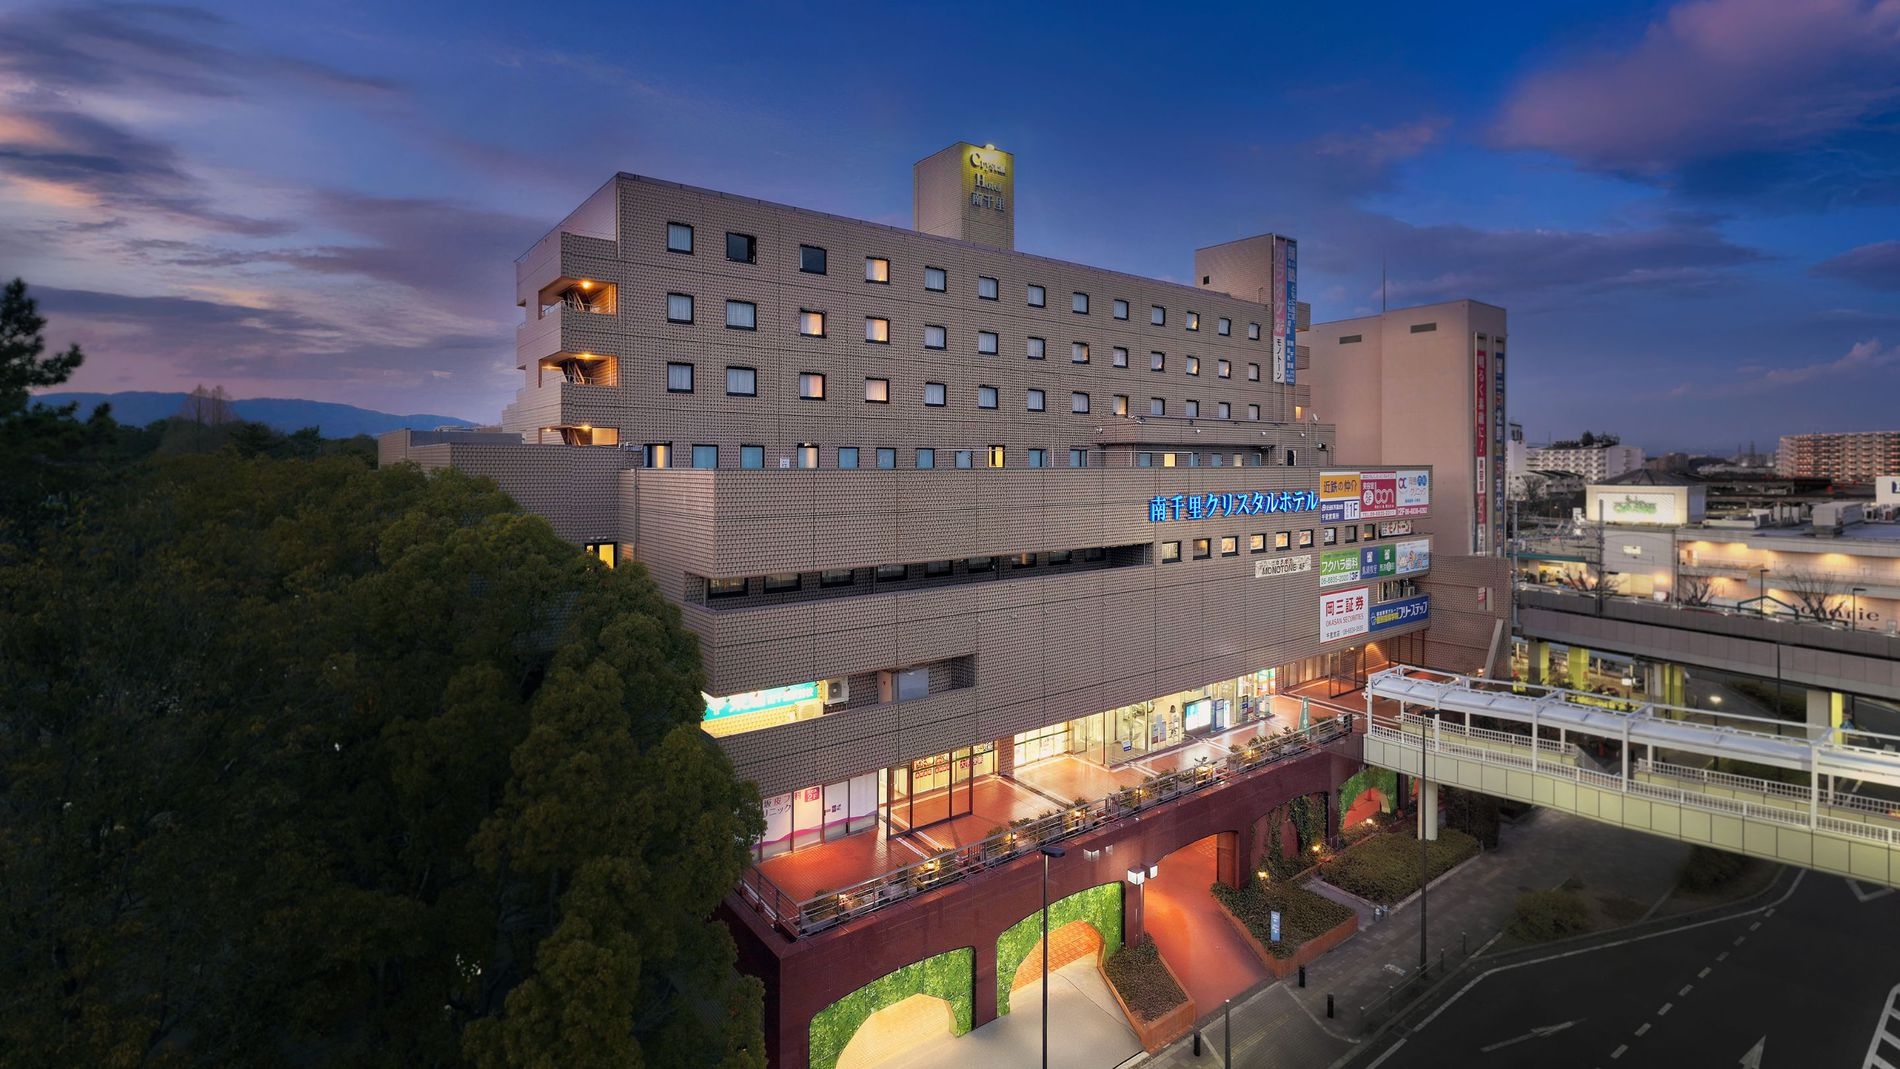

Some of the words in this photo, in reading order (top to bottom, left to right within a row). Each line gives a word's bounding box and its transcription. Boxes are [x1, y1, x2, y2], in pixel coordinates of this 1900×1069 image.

[975, 173, 1001, 192] Hotel
[971, 190, 1005, 212] 南千里
[1323, 479, 1357, 493] 近鉄の仲介
[1150, 490, 1318, 522] 南千里クリスタルホテル
[1262, 562, 1296, 575] MONOTONE
[1321, 557, 1358, 573] フクハラ歯科
[1326, 596, 1364, 616] 岡三証券
[1325, 617, 1343, 627] OKASAN
